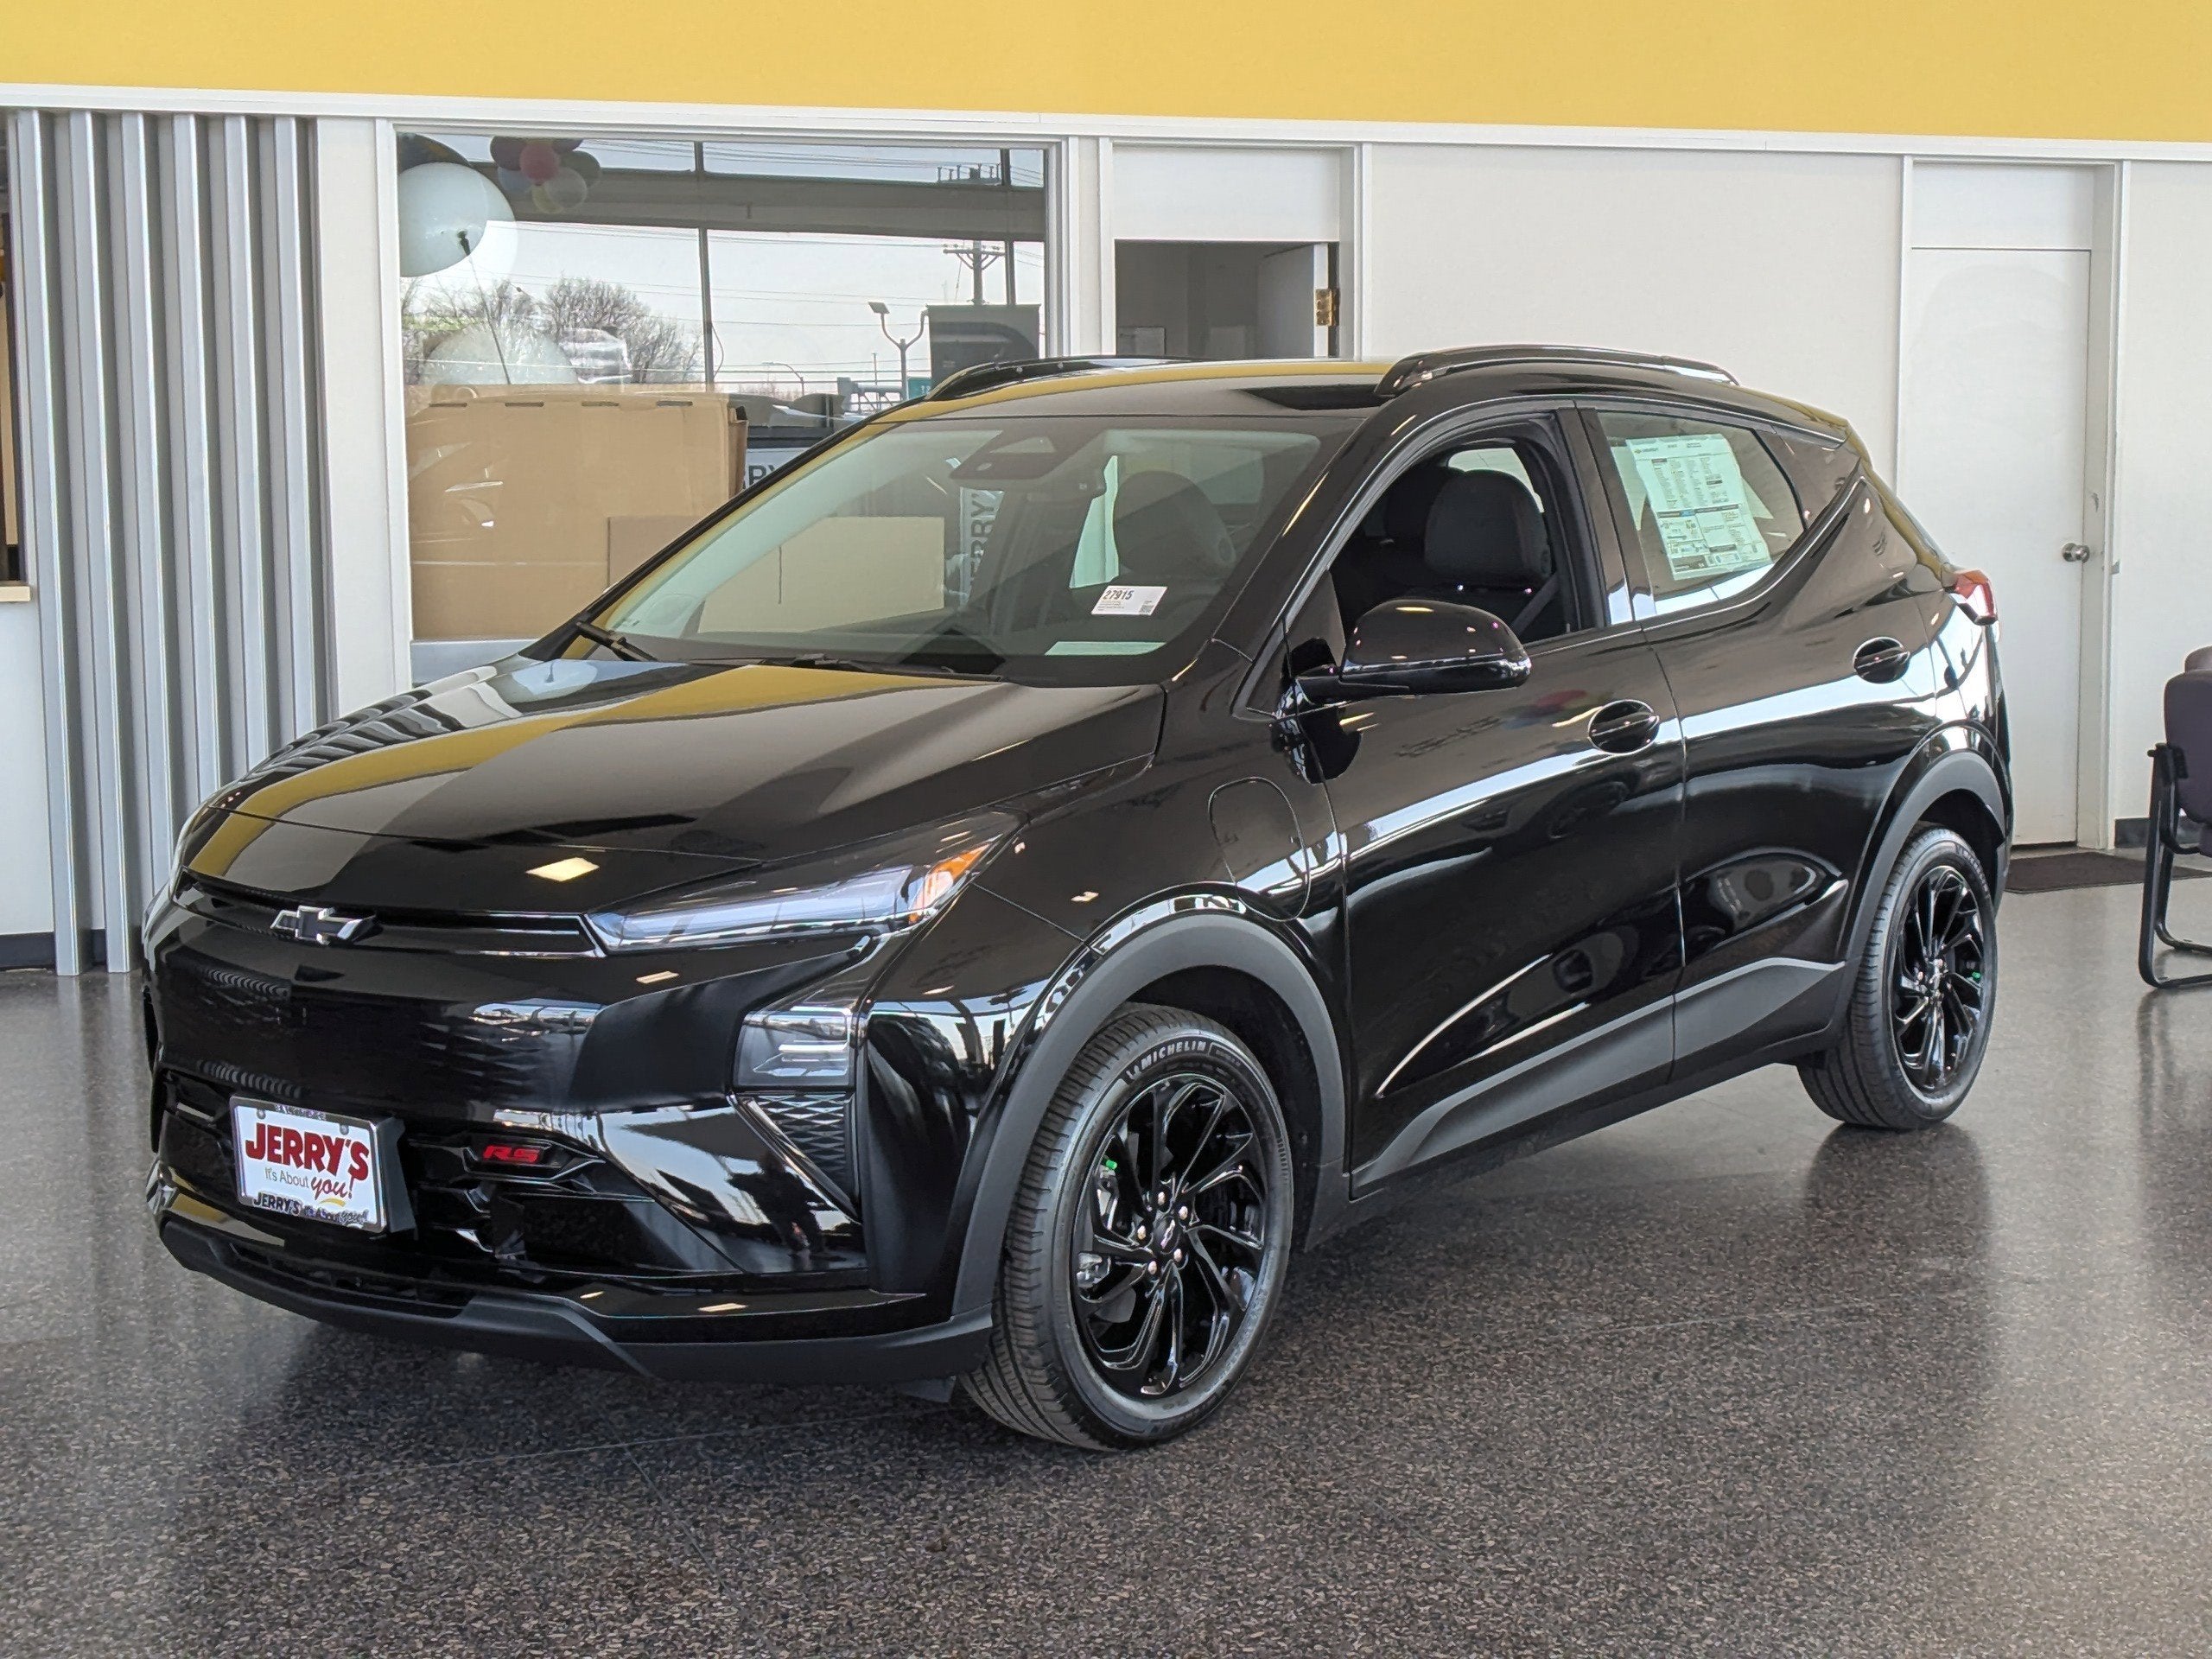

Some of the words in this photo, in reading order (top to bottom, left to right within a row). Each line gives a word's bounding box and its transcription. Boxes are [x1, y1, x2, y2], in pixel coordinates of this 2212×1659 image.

[1103, 590, 1134, 601] 27915
[1141, 1040, 1206, 1071] MICHELIN
[245, 1122, 370, 1181] JERRY'S
[482, 1145, 540, 1163] RS
[264, 1166, 277, 1182] It's
[279, 1170, 309, 1188] About
[311, 1175, 355, 1200] you!
[253, 1192, 301, 1215] JERRY'S
